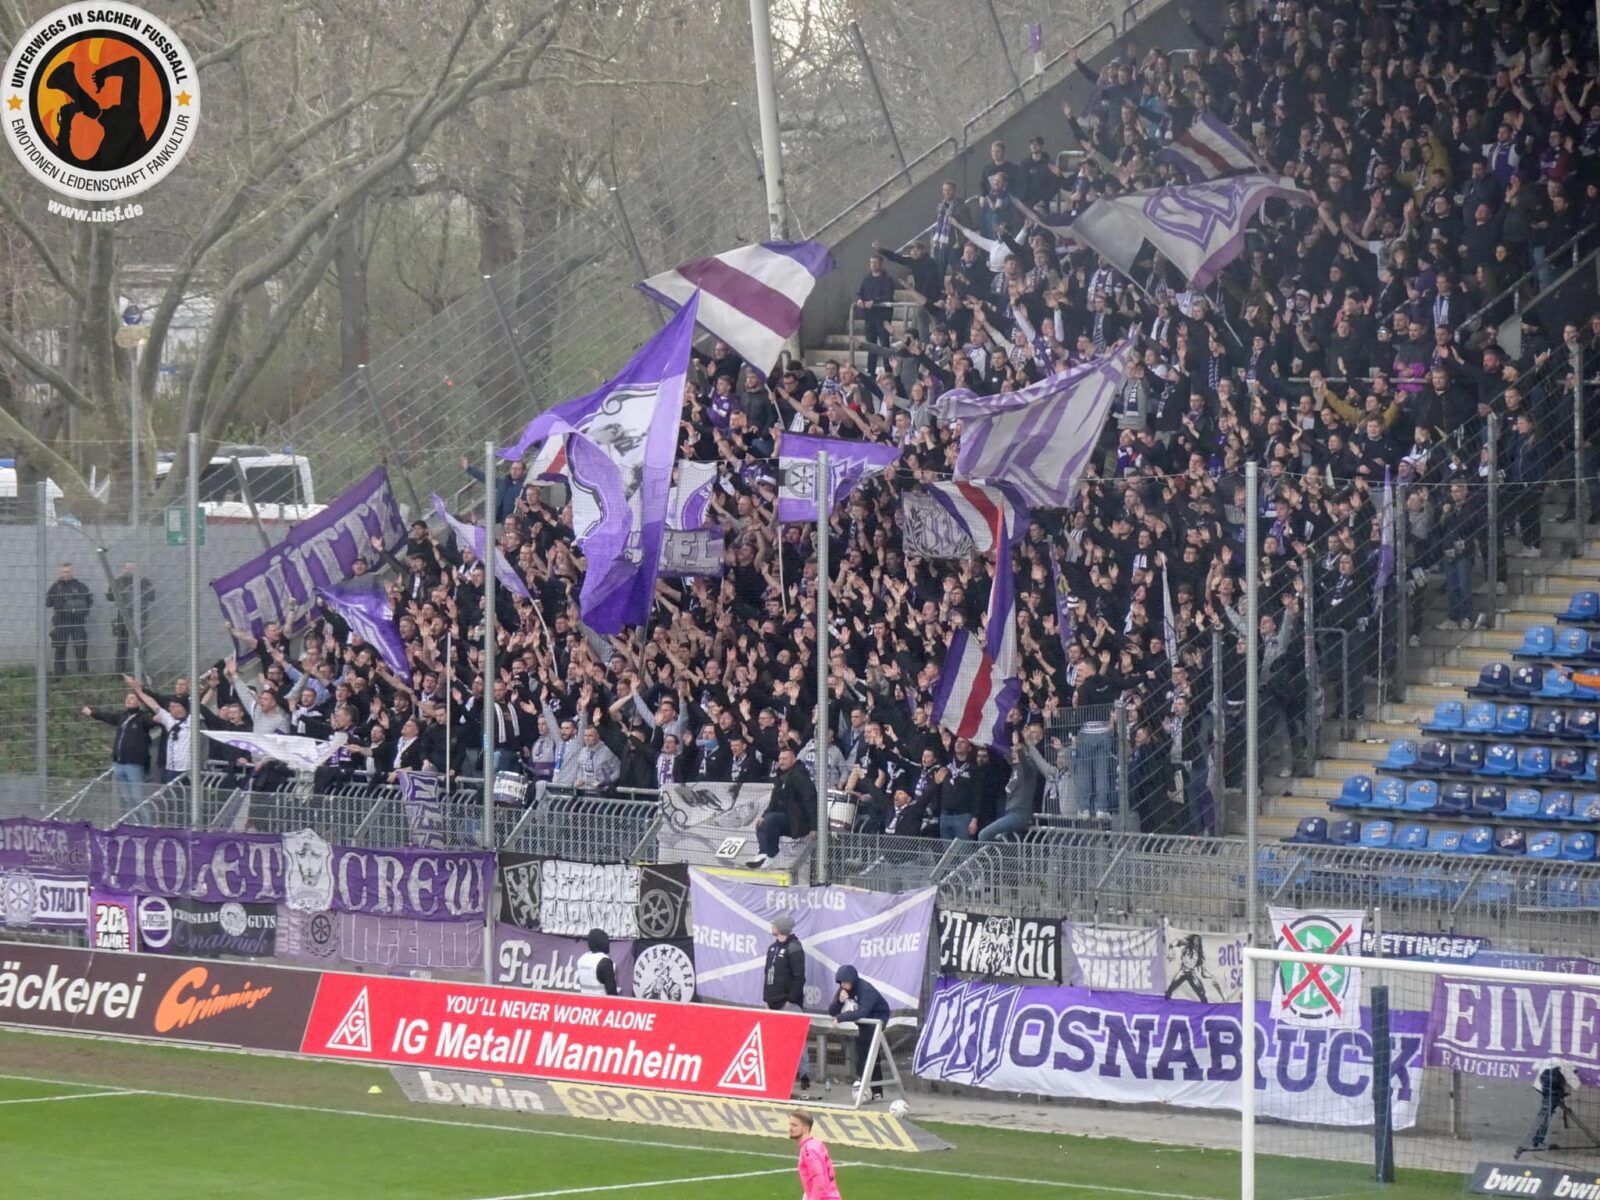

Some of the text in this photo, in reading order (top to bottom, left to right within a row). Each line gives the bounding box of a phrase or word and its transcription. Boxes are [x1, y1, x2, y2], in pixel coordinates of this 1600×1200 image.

[720, 840, 740, 855] 26
[96, 834, 283, 899] VIOLET
[338, 851, 485, 916] CREW
[542, 859, 640, 903] SEZIONE
[39, 884, 86, 912] STADT
[247, 915, 276, 929] GUYS
[96, 932, 130, 949] JAHRE
[692, 924, 757, 955] BREMER
[1362, 932, 1481, 958] METTINGEN
[1078, 957, 1153, 989] RHEINE
[155, 967, 272, 1033] Grimminger
[499, 999, 550, 1019] NEVER
[553, 1005, 602, 1026] WORK
[603, 1011, 656, 1031] ALONE
[392, 1018, 702, 1082] IG Metall Mannheim
[1442, 1051, 1520, 1078] RAUCHEN
[419, 1071, 904, 1147] bwin SPORTWETEN
[1484, 1167, 1542, 1194] bwin
